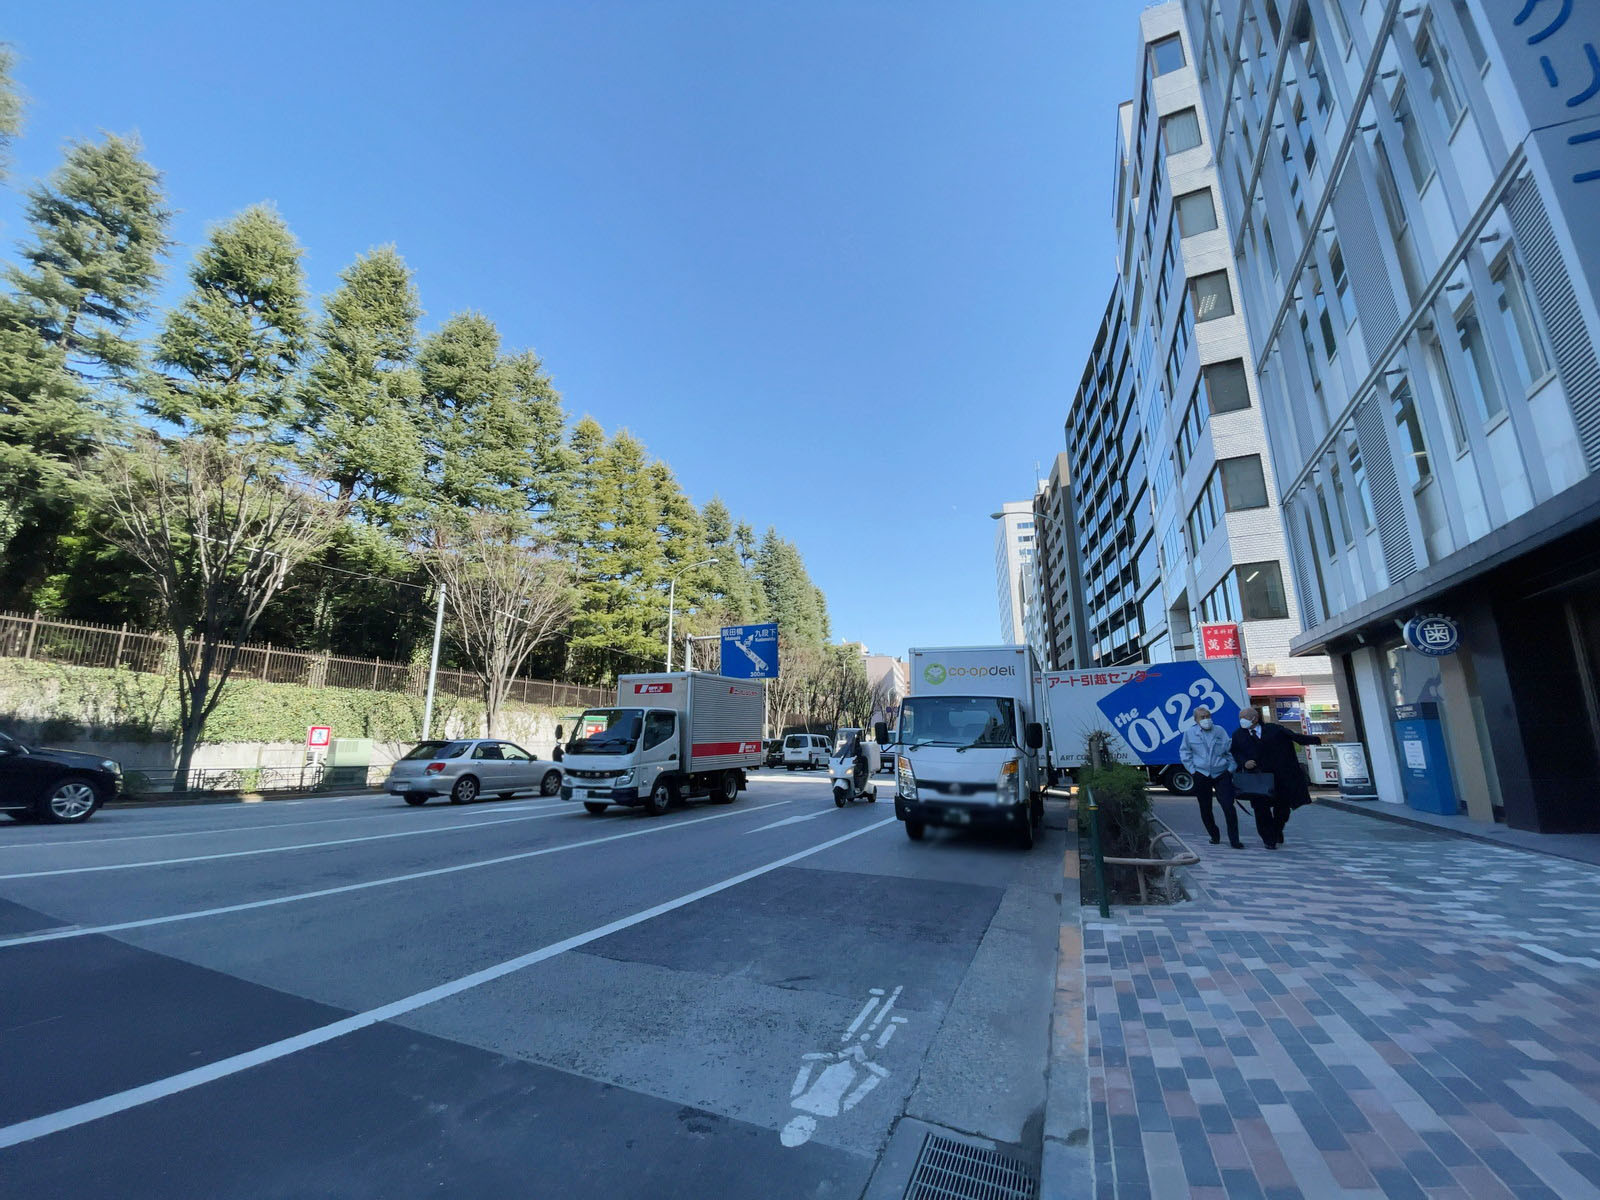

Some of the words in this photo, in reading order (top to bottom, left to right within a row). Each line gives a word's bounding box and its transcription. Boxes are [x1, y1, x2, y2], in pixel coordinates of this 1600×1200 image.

[755, 629, 776, 638] 九段下
[1424, 623, 1450, 644] 歯
[1048, 671, 1162, 688] アート引越センター
[1114, 708, 1139, 728] the
[1129, 678, 1225, 753] 0123
[1060, 753, 1074, 761] ART
[1325, 771, 1338, 779] KI
